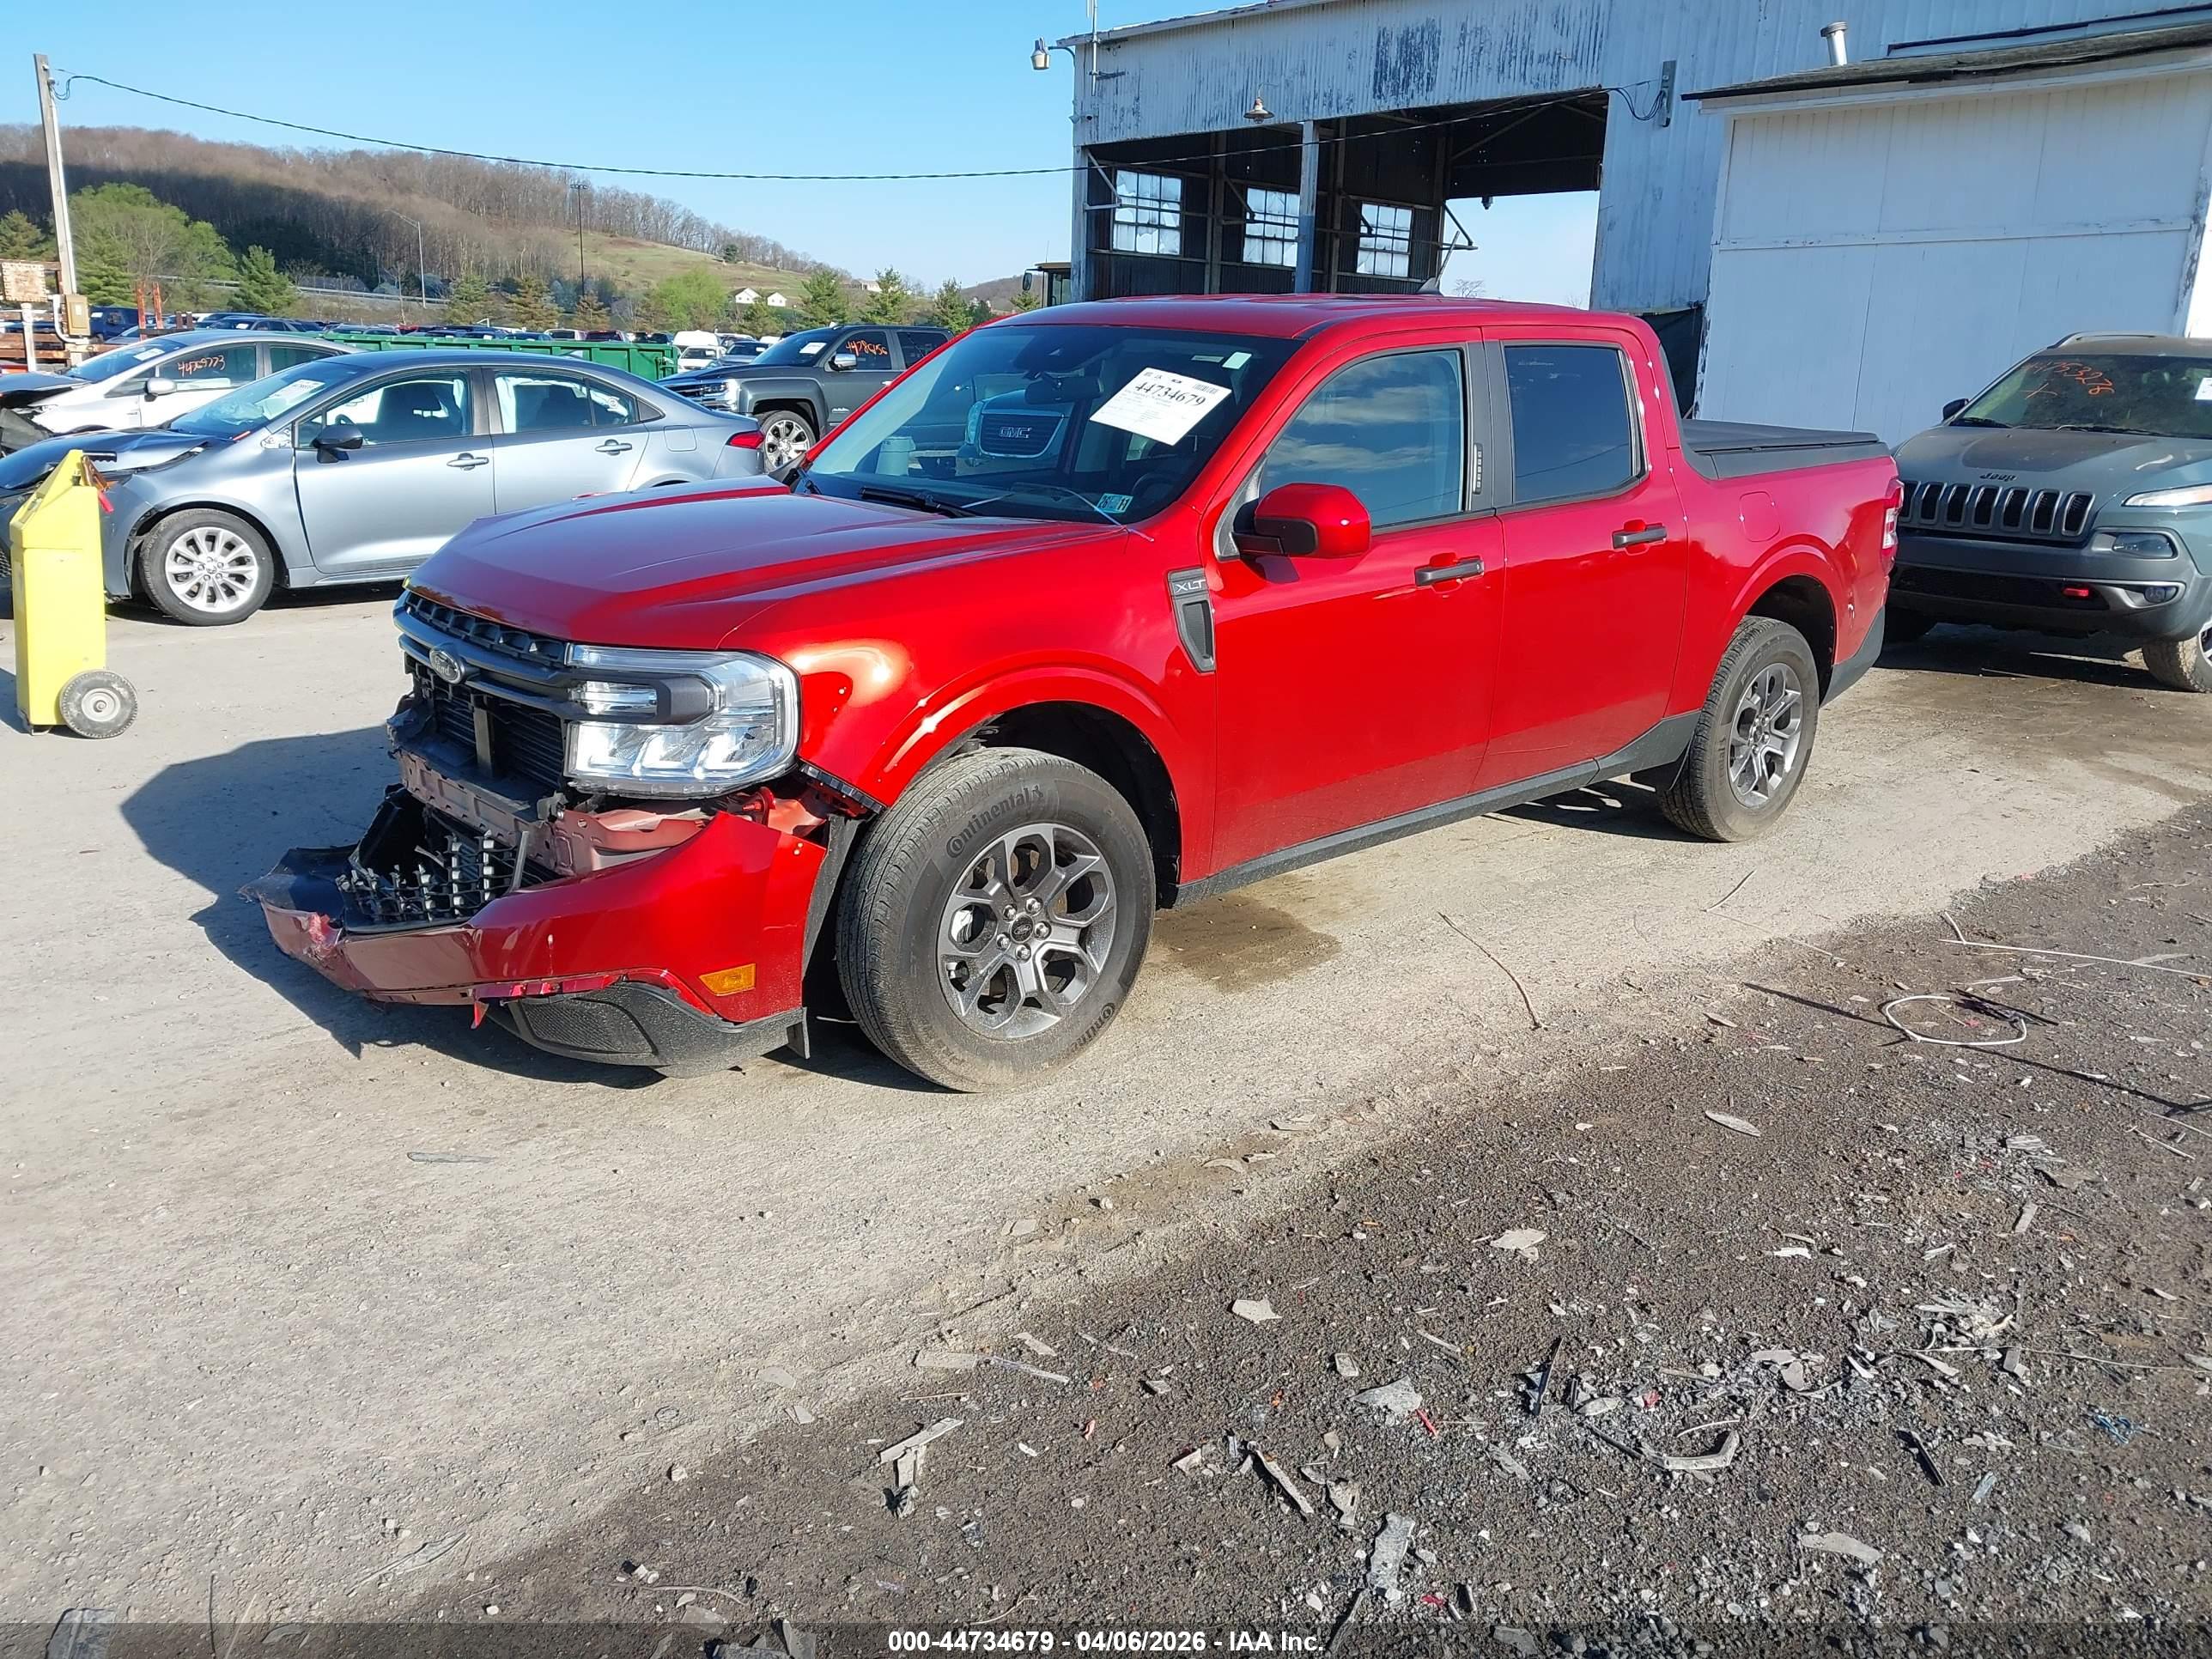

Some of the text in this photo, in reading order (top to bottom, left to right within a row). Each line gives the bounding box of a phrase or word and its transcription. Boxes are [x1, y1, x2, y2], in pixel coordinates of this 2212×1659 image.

[1135, 381, 1206, 406] 44734679
[1176, 579, 1206, 592] XLT
[946, 786, 1030, 858] Continental
